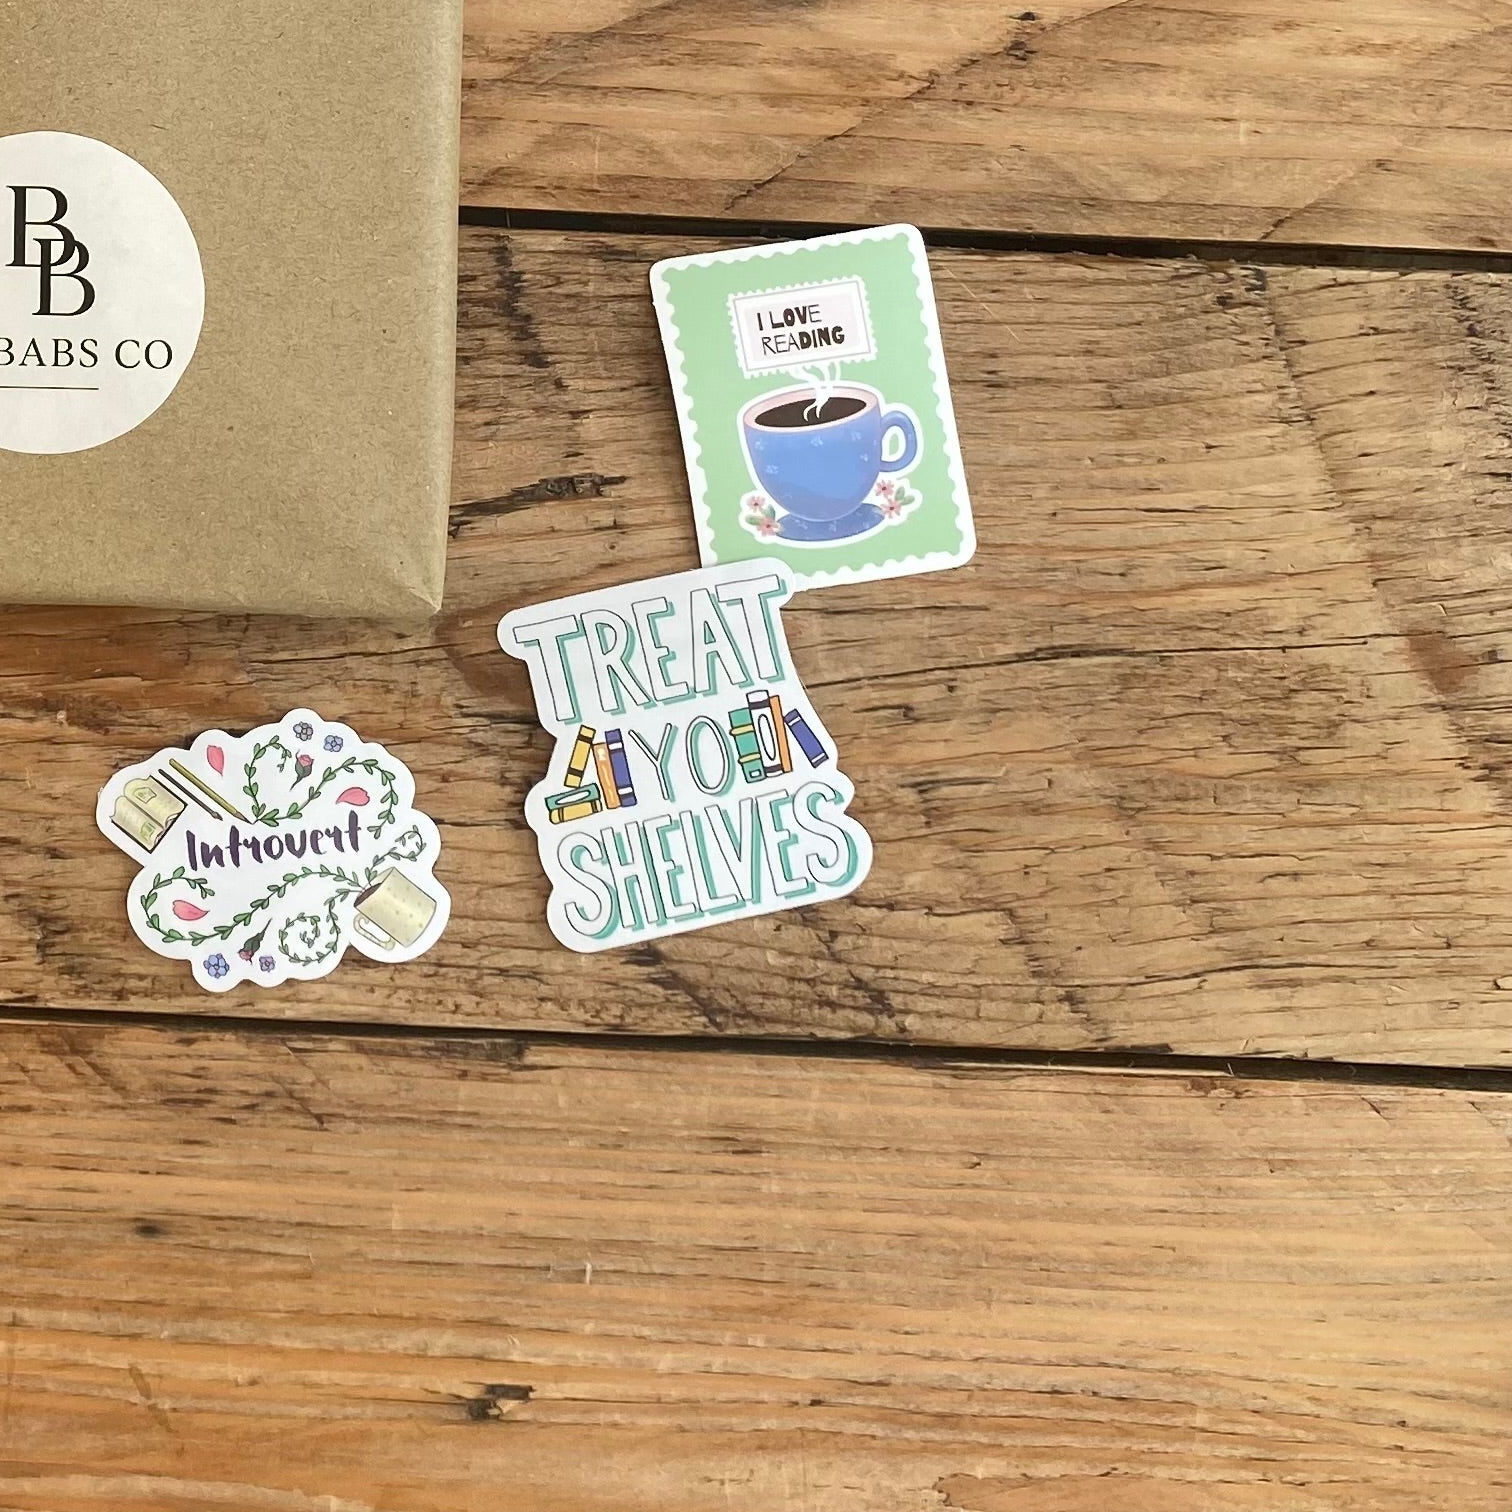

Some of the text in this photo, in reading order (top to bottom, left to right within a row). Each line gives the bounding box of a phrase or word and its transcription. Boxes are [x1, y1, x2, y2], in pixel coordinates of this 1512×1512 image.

[756, 303, 823, 331] I LOVE
[761, 325, 846, 356] READING
[114, 339, 174, 370] CO
[512, 574, 788, 724] TREAT
[628, 715, 737, 802] YO
[186, 810, 362, 872] Introvert
[557, 780, 859, 940] SHELVES
